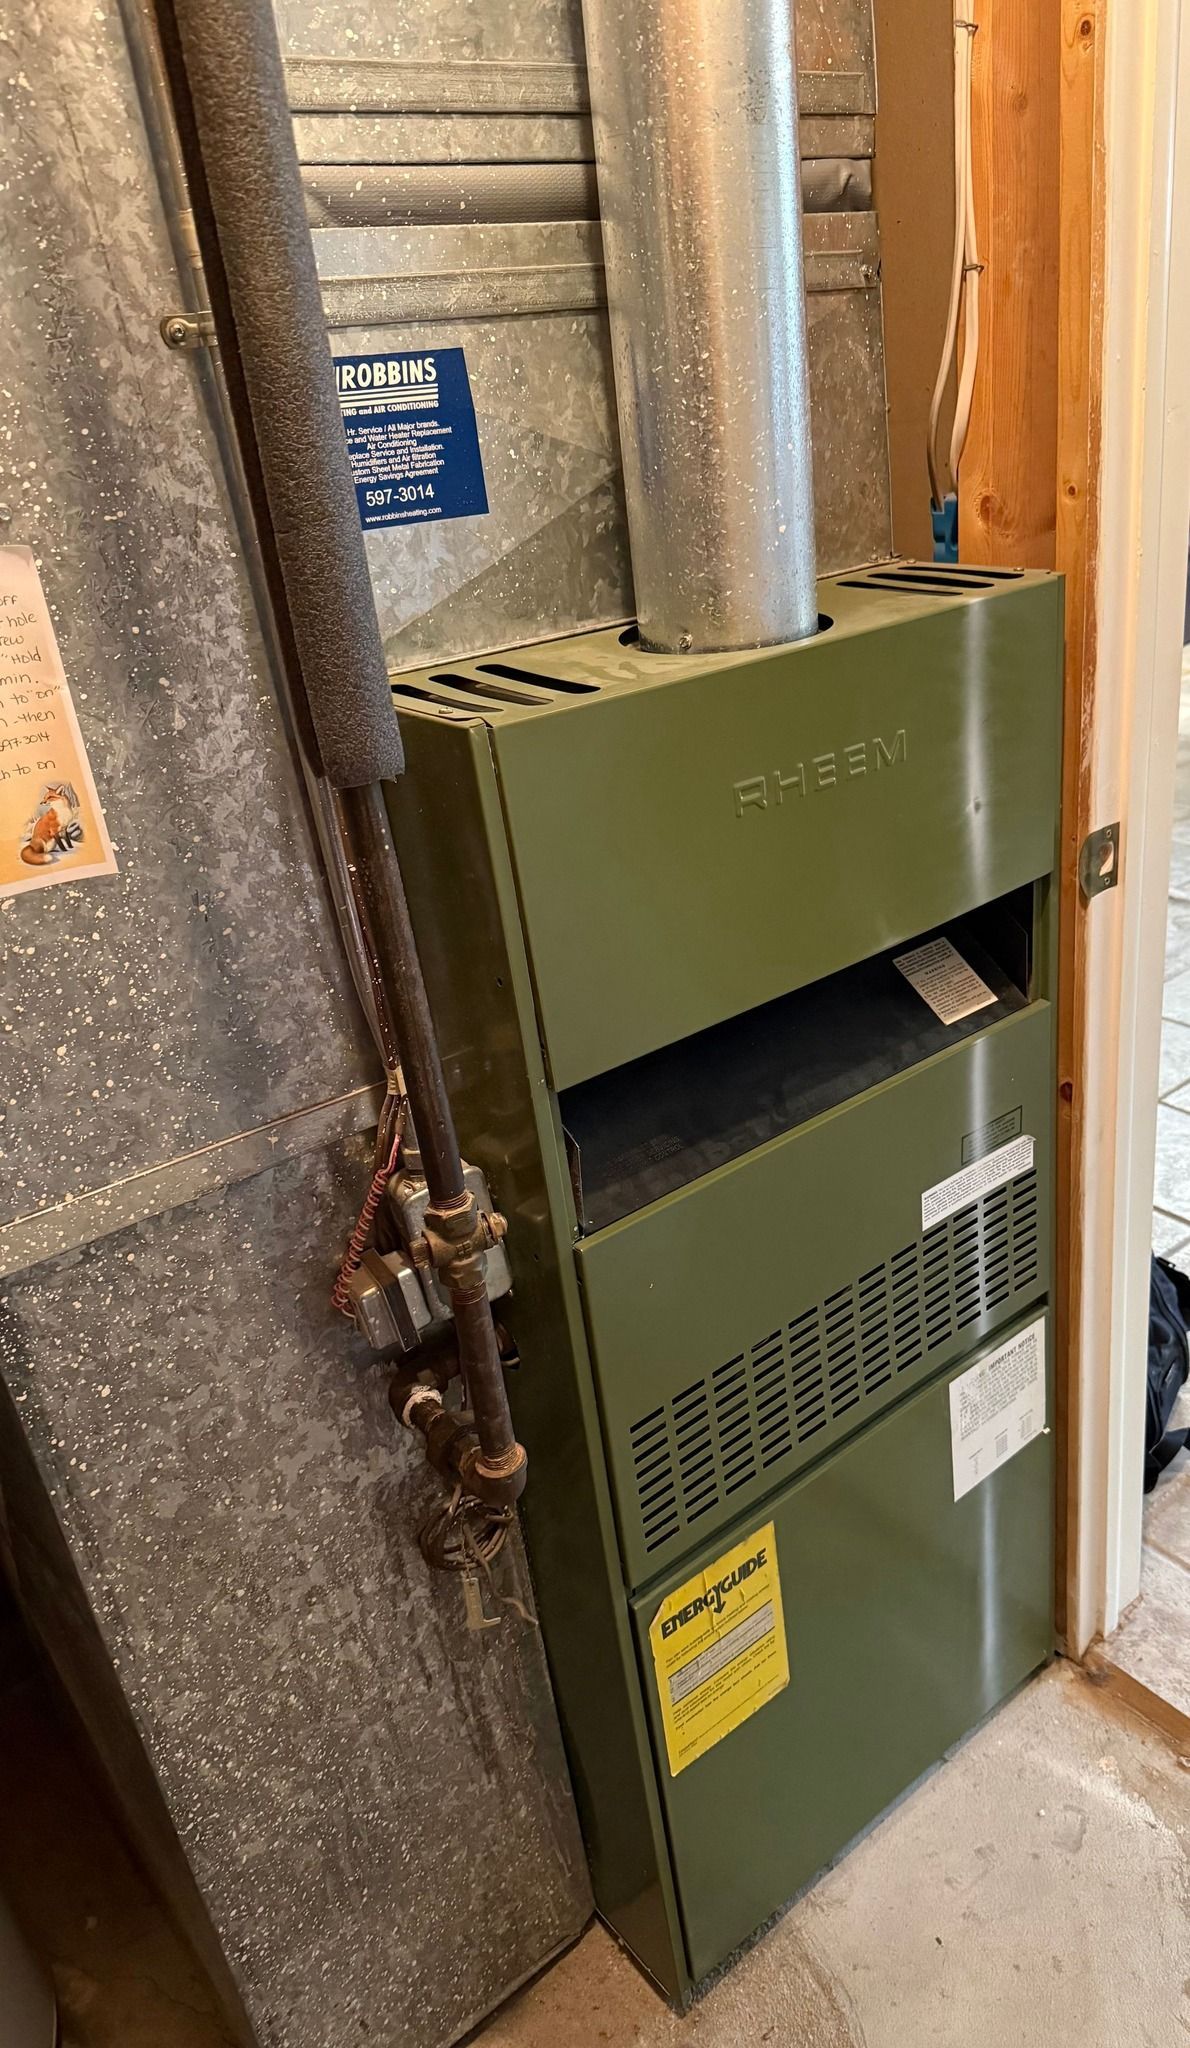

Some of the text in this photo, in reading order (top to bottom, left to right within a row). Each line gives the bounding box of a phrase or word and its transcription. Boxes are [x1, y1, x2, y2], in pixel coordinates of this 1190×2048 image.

[341, 357, 437, 389] ROBBINS
[358, 407, 372, 415] and
[374, 405, 386, 414] AIR
[387, 400, 439, 413] CONDITIONING
[347, 428, 357, 437] Hr.
[358, 426, 383, 435] Service
[387, 423, 396, 432] All
[397, 421, 416, 431] Major
[416, 420, 440, 429] brands.
[354, 435, 367, 443] and
[368, 433, 387, 442] Water
[389, 431, 410, 440] Heater
[411, 426, 452, 438] Replacement
[367, 439, 417, 450] Air Conditioning
[351, 458, 387, 468] Humidifiers
[388, 456, 400, 464] and
[402, 454, 410, 462] Air
[371, 449, 395, 457] Service
[371, 465, 391, 474] Sheet
[392, 463, 410, 471] Metal
[410, 459, 445, 469] Fabrication
[354, 467, 439, 484] Energy Savings Agreement
[366, 483, 435, 507] 597-3014
[365, 507, 442, 523] www.robbinsheating.com
[9, 693, 28, 704] to
[12, 763, 31, 775] to
[36, 760, 56, 770] on
[733, 729, 906, 818] RHEEM
[661, 1548, 767, 1640] ENERGYGUIDE
